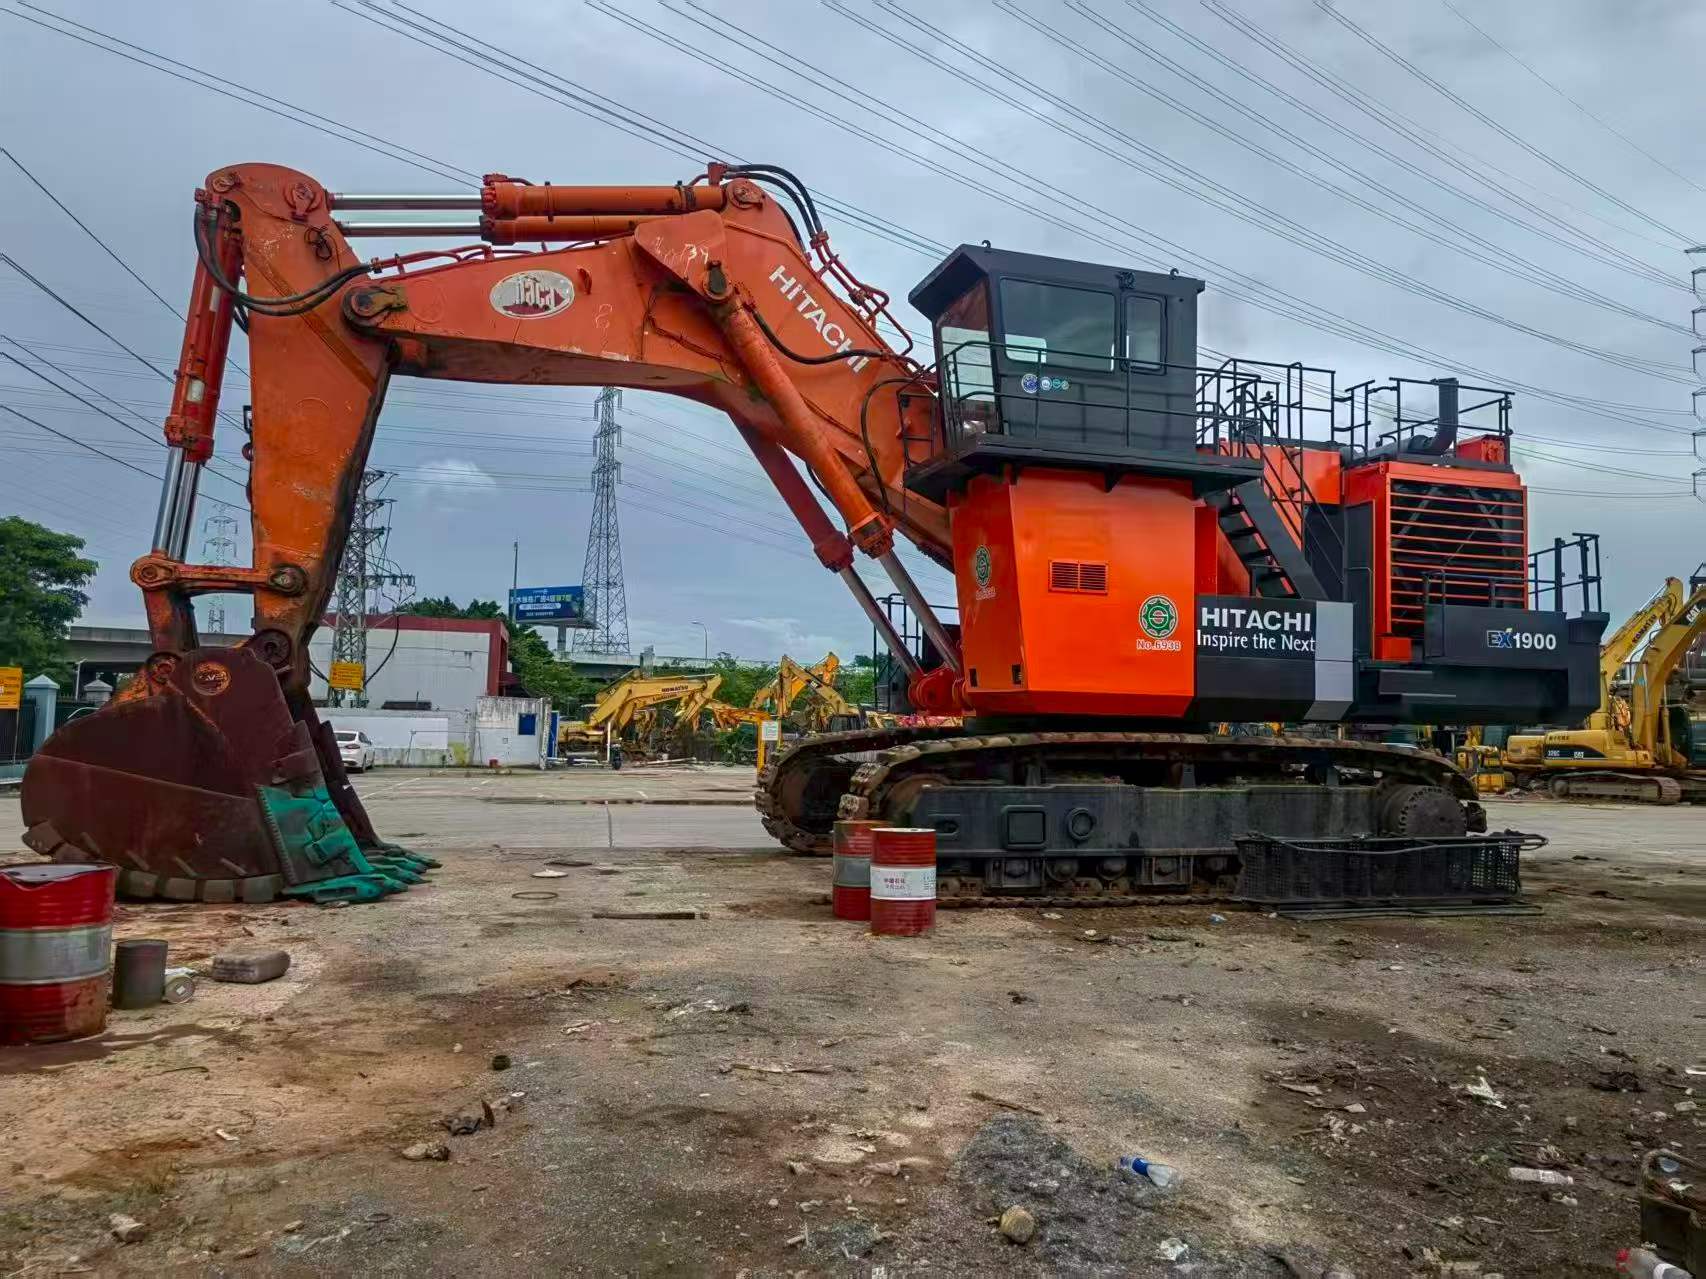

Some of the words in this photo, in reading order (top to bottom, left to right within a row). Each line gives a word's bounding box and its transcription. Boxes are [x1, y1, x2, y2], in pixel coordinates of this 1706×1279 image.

[769, 265, 870, 373] HITACHI
[1201, 607, 1311, 632] HITACHI
[1197, 629, 1248, 651] Inspire
[1252, 632, 1277, 650] the
[1281, 634, 1316, 652] Next
